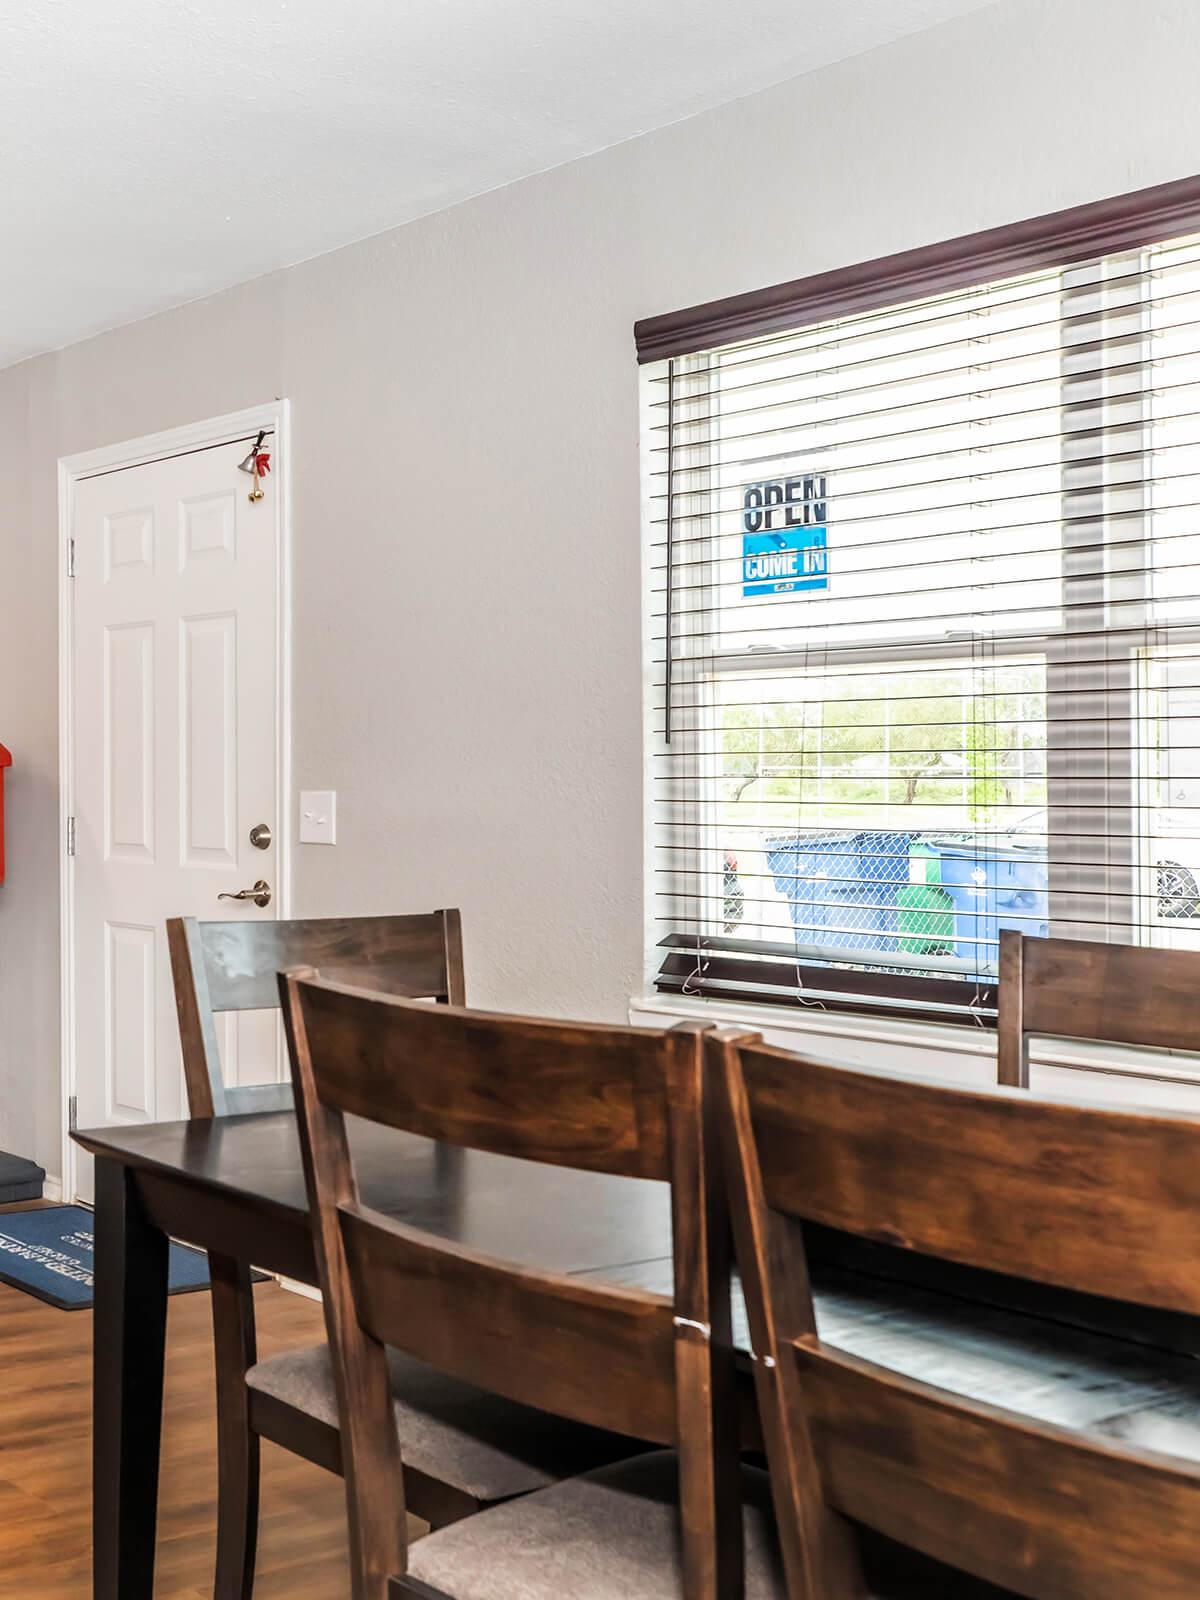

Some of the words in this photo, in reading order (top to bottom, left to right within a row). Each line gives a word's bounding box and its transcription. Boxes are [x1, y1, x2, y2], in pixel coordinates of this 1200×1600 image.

[744, 475, 826, 532] OPEN
[746, 548, 798, 579] COME
[803, 545, 825, 573] IN
[44, 1262, 94, 1286] NITED
